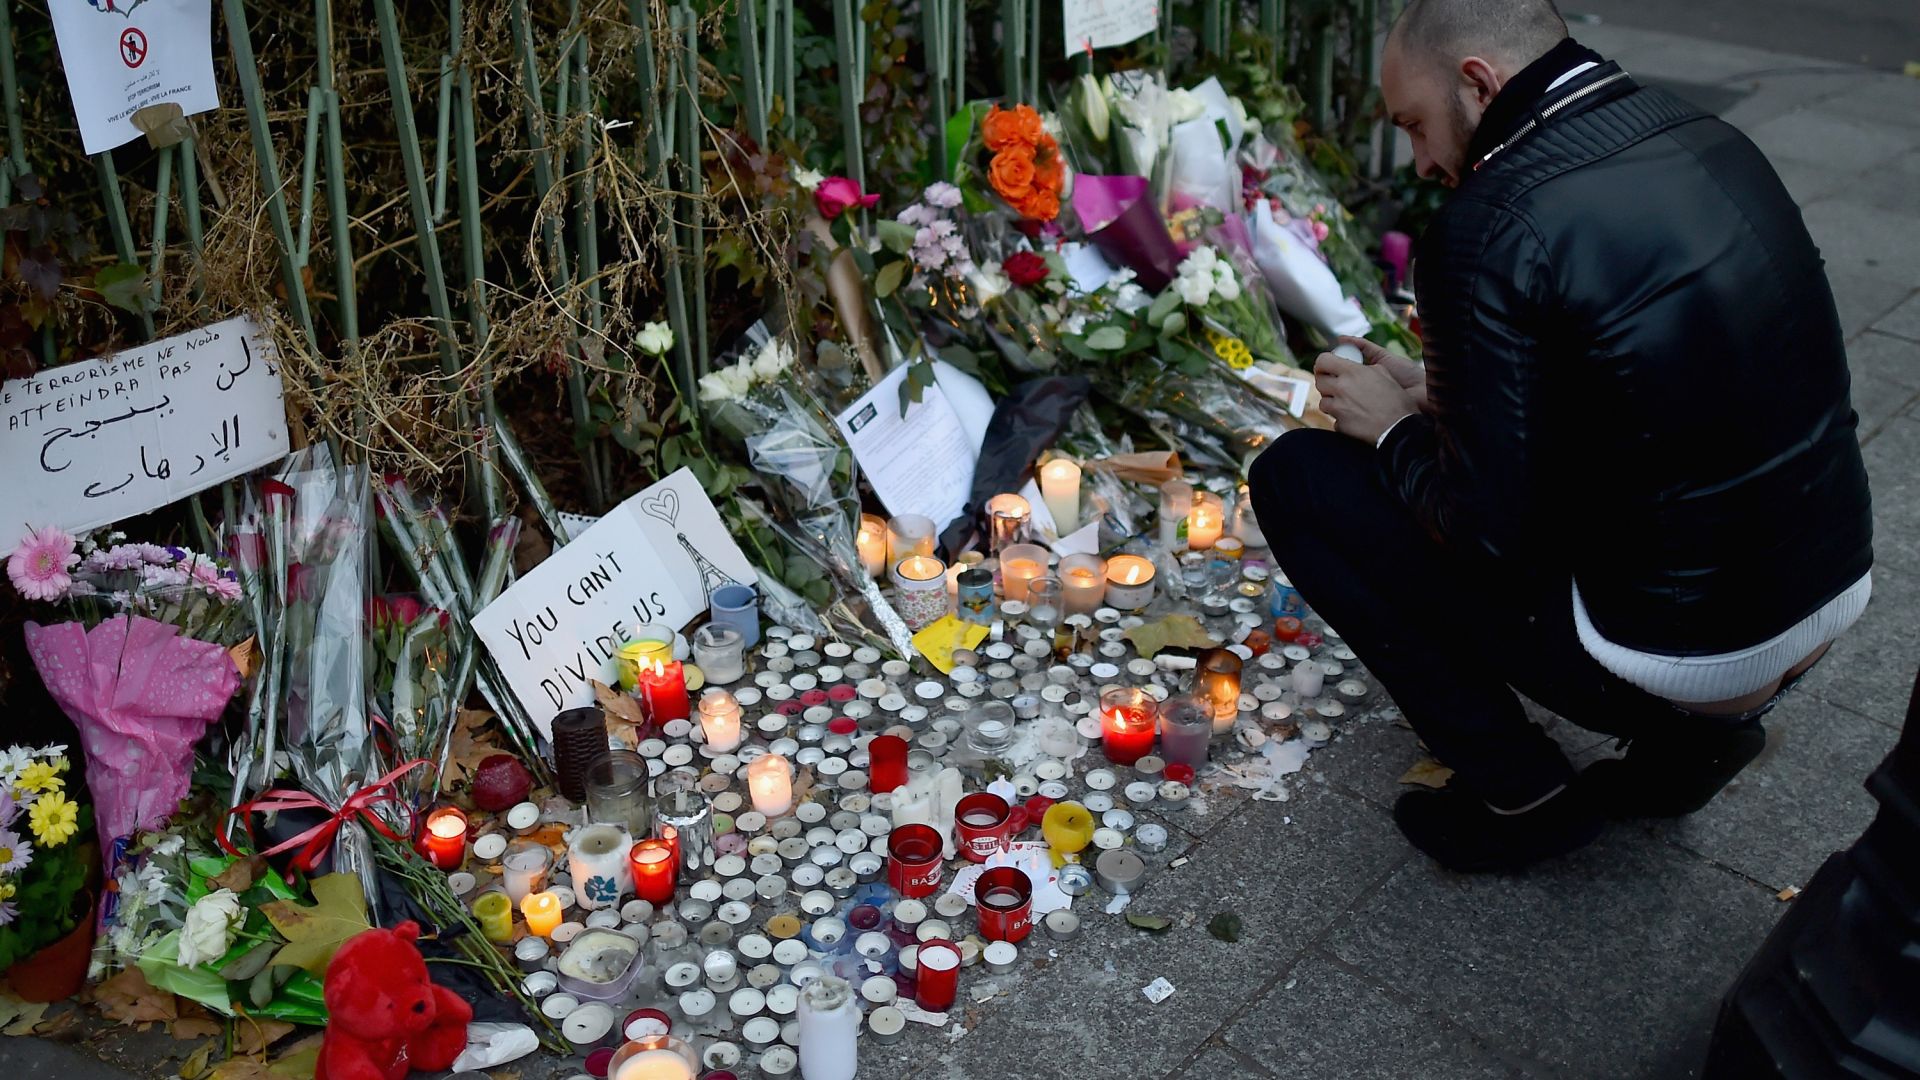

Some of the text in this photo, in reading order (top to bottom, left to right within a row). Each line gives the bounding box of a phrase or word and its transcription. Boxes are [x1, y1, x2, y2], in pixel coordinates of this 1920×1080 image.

[107, 113, 119, 123] VIVE
[150, 93, 160, 102] VIVE
[168, 85, 192, 96] FRANCE
[0, 393, 12, 406] E
[157, 345, 176, 363] NE
[159, 361, 192, 380] PAS
[216, 336, 251, 391] لن
[505, 550, 623, 661] YOU CAN'T
[632, 591, 666, 624] US
